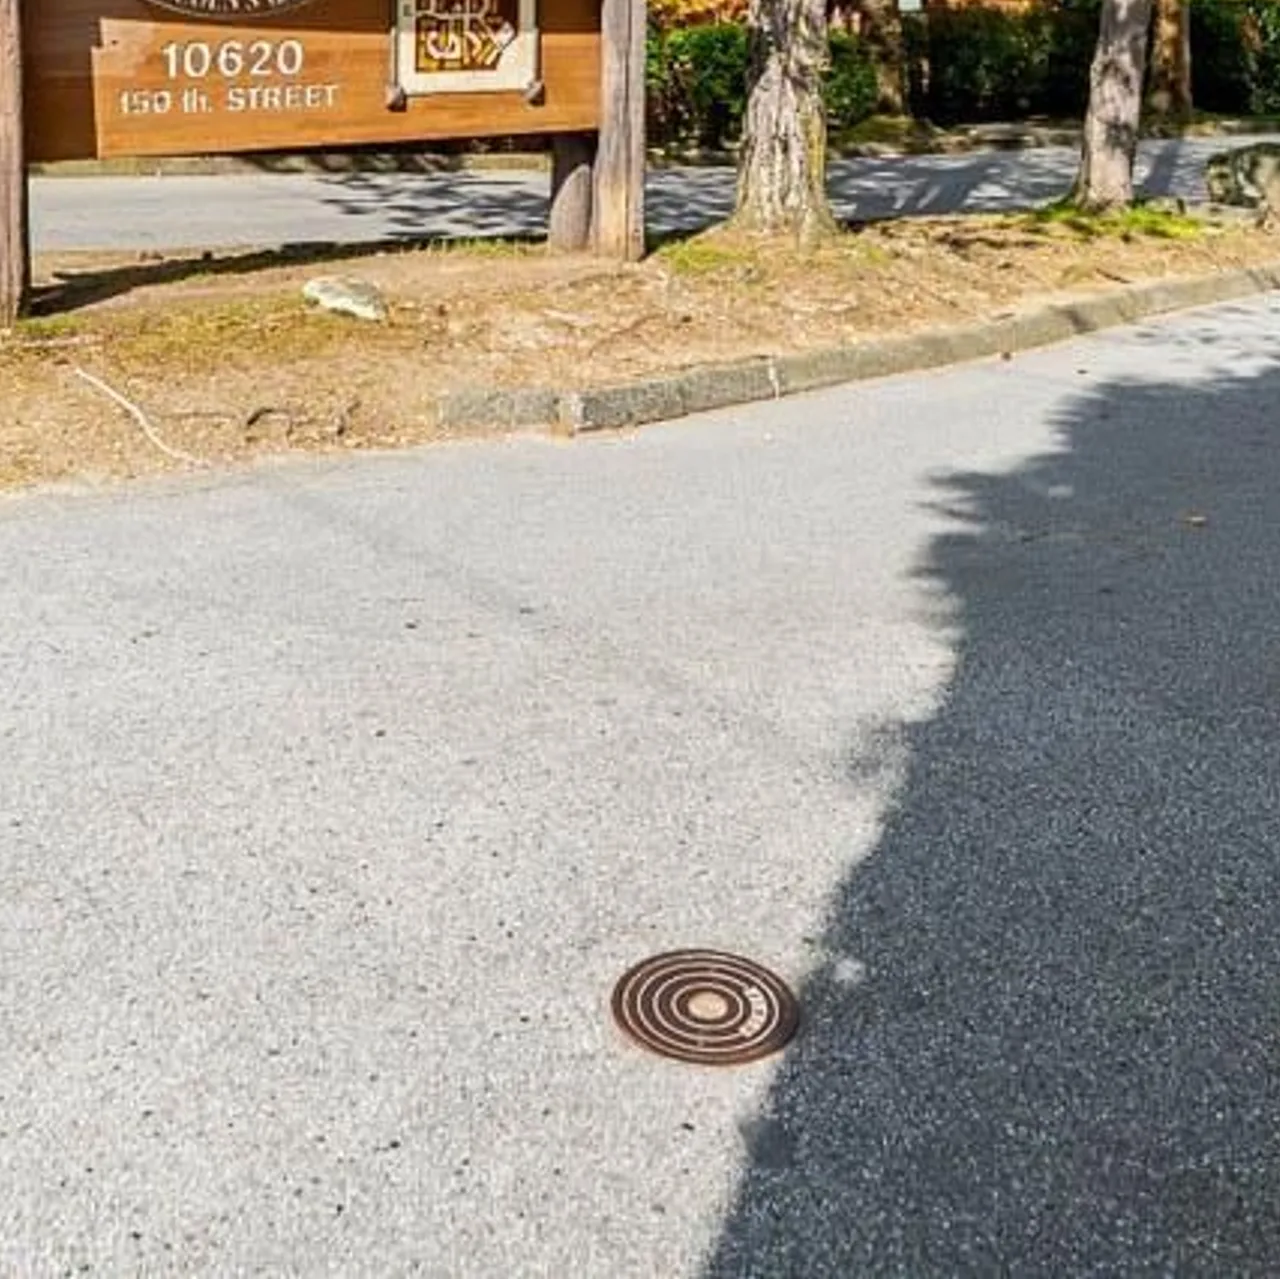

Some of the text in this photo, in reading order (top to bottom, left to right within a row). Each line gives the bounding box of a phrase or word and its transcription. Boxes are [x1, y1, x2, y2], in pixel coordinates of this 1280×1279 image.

[161, 38, 304, 79] 10620
[119, 89, 172, 115] 150
[226, 84, 340, 112] STREET
